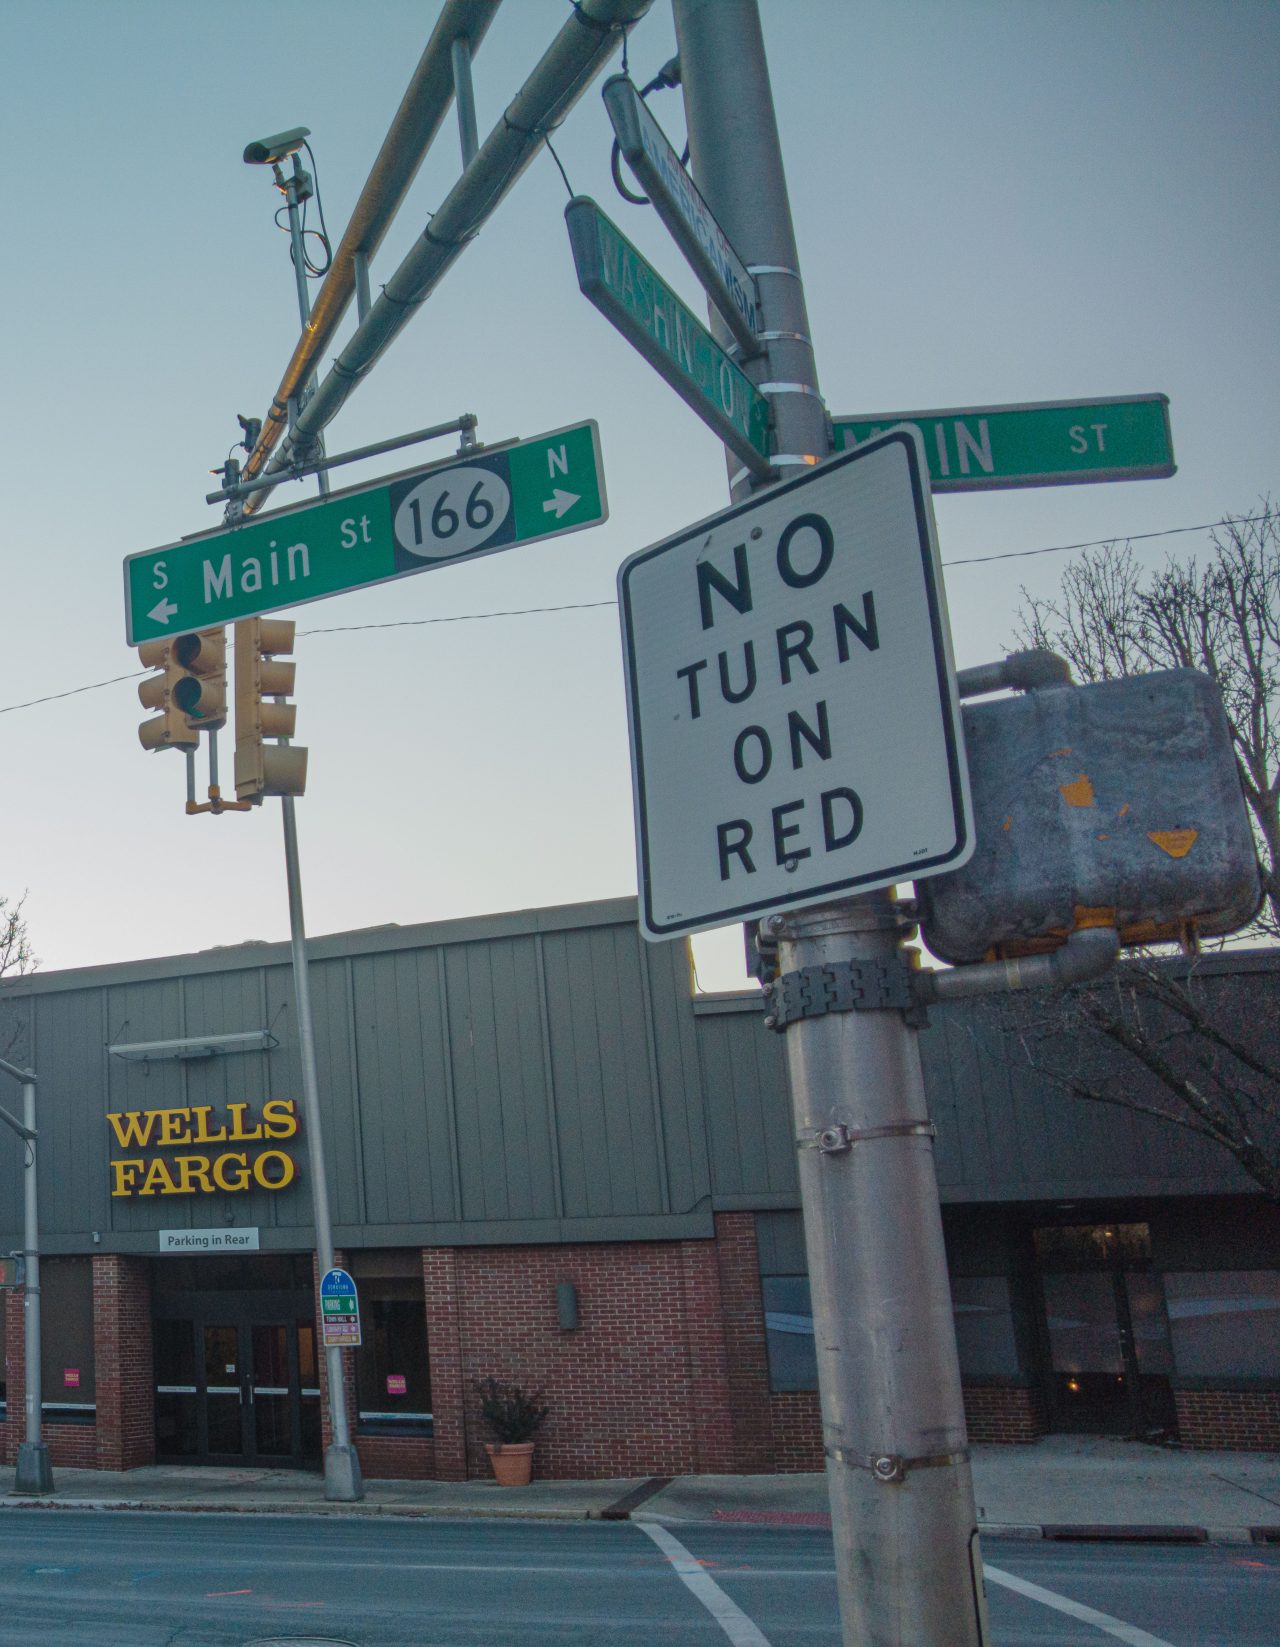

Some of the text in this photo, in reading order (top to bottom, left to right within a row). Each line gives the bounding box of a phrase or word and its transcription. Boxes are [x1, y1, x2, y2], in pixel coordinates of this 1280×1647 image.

[842, 419, 1108, 477] IN ST
[152, 444, 570, 604] S Main St 166 N
[695, 512, 835, 631] NO
[676, 590, 880, 721] TURN
[733, 700, 833, 786] ON
[716, 786, 864, 881] RED
[106, 1100, 298, 1148] WELLS
[110, 1150, 295, 1197] FARGO
[167, 1234, 250, 1248] Parking in Rear
